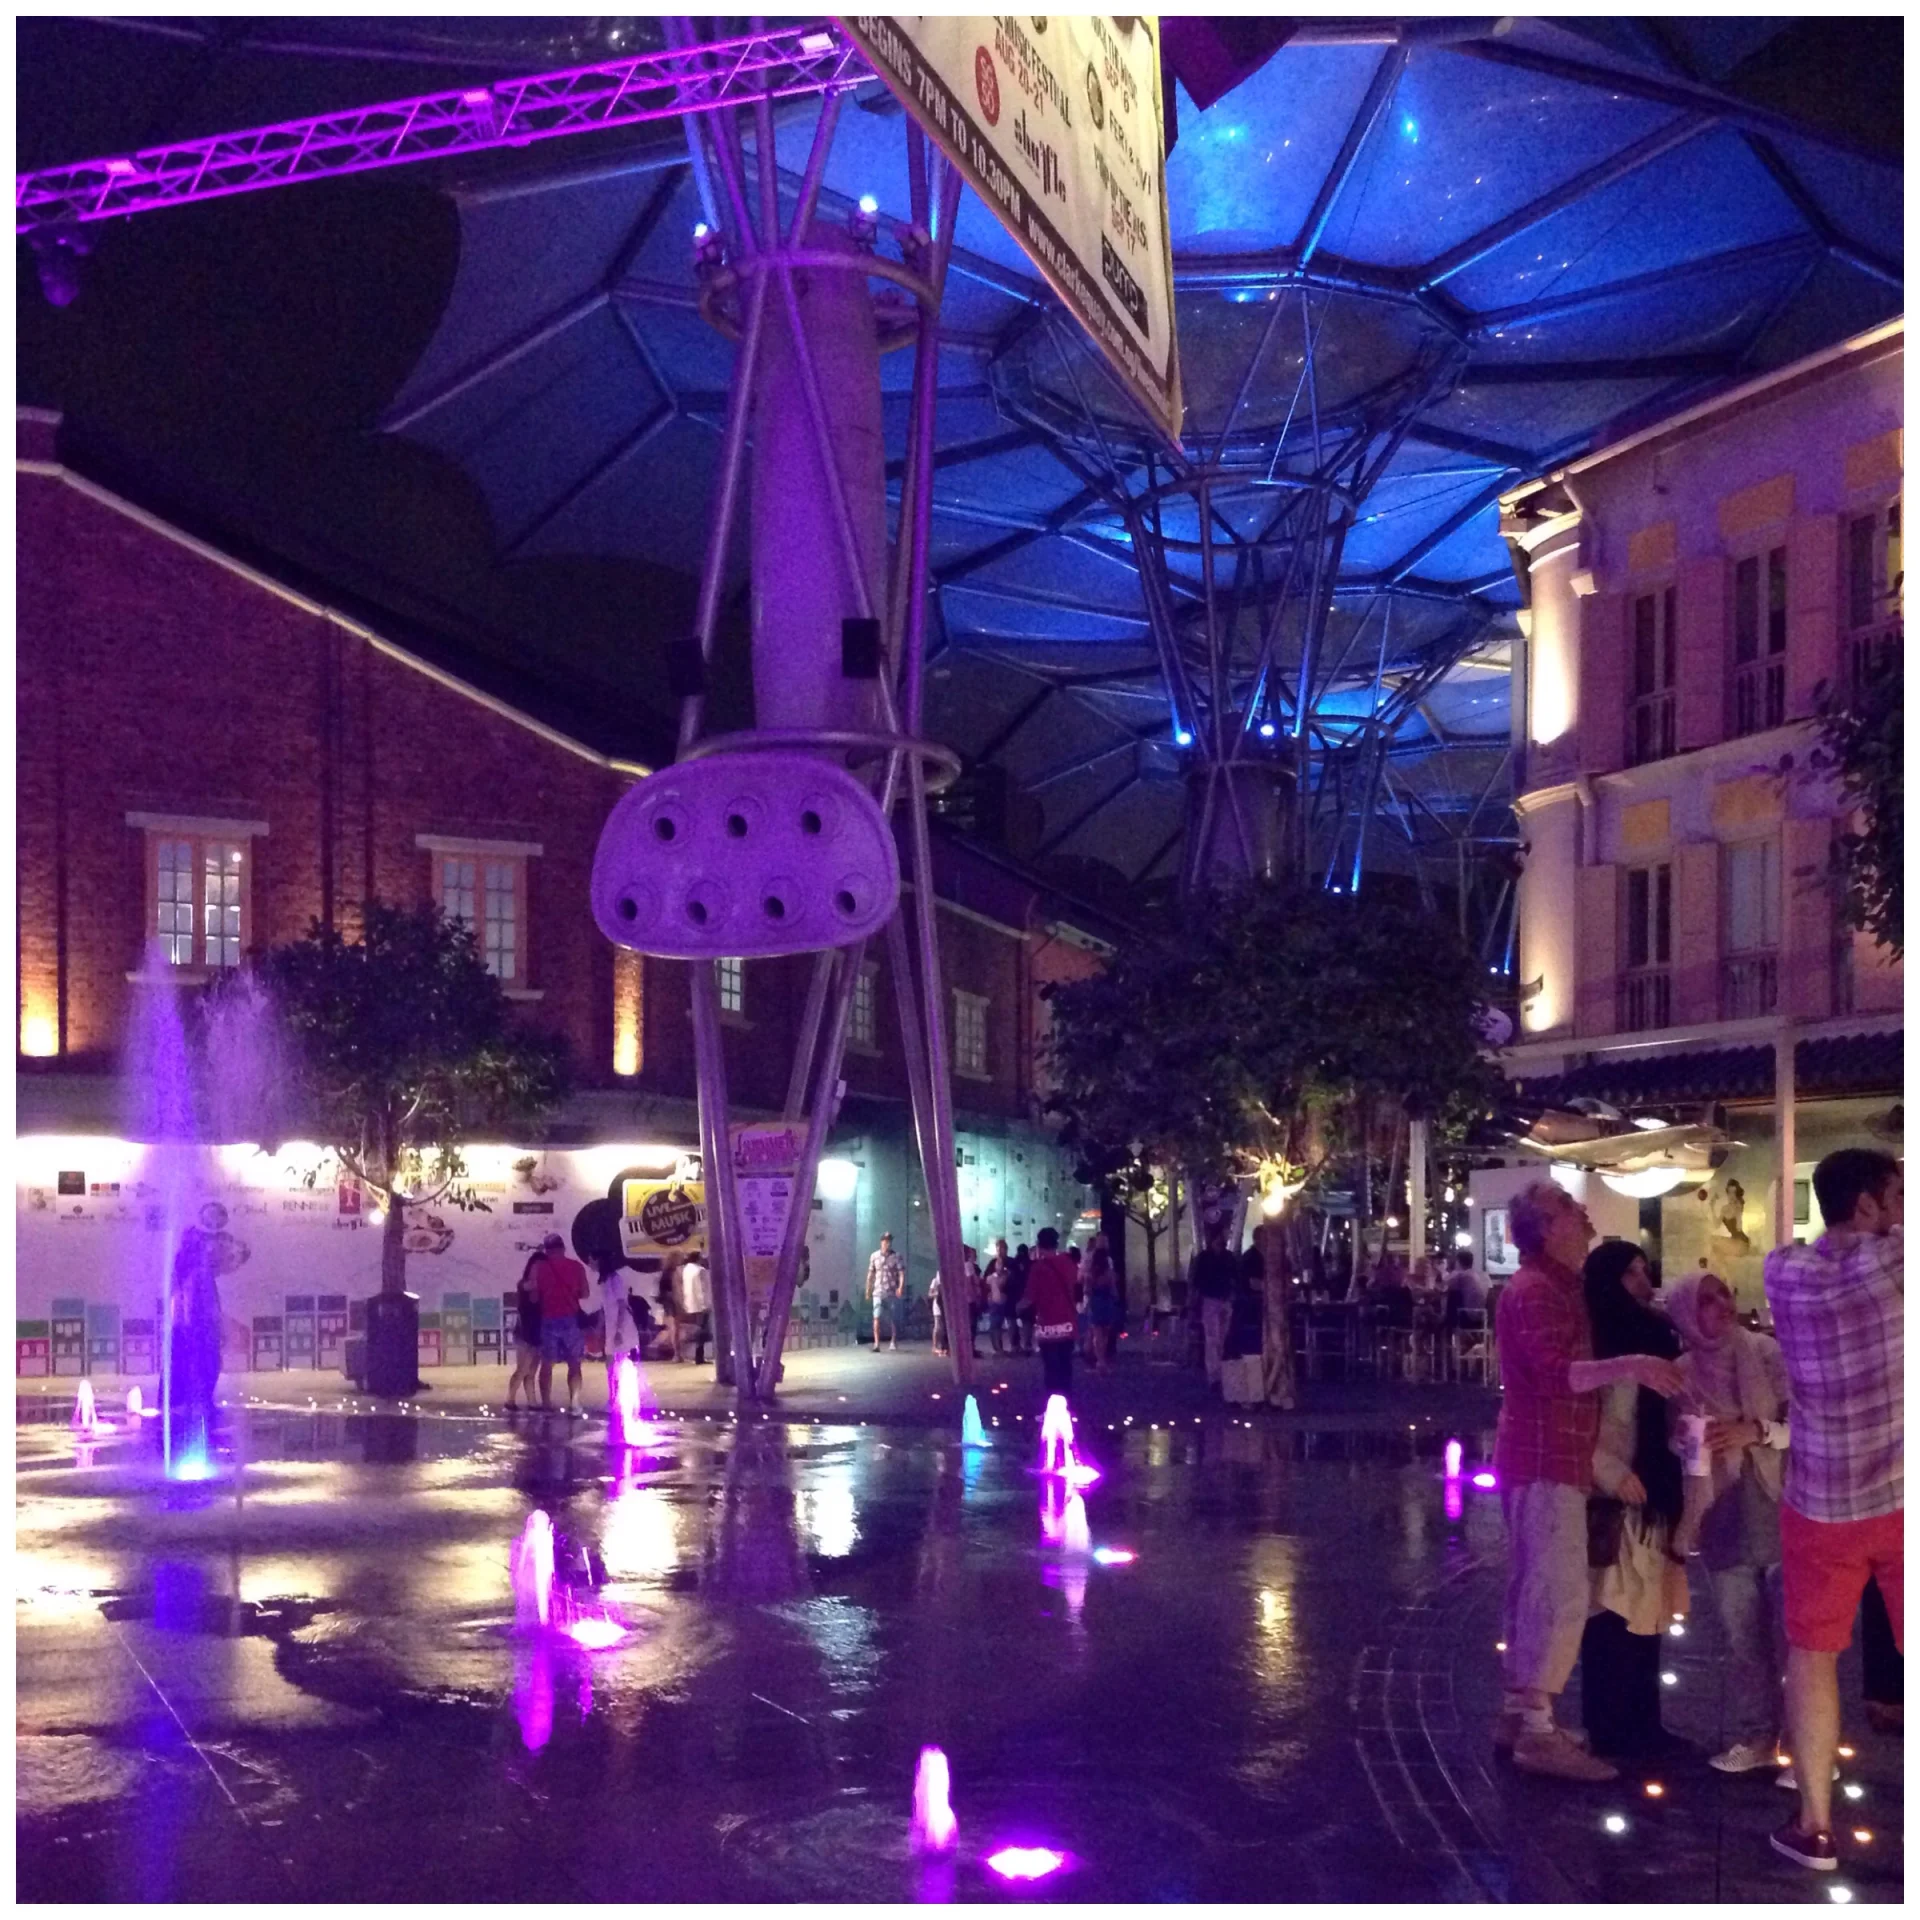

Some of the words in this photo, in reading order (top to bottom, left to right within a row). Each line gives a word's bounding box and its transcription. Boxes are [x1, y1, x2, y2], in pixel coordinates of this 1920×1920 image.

[995, 26, 1016, 77] AUG
[1018, 60, 1045, 117] 20-21
[858, 16, 912, 87] BEGINS
[916, 67, 947, 129] 7PM
[950, 107, 967, 154] TO
[971, 137, 1021, 224] 10.30PM
[646, 1201, 671, 1218] LIVE
[650, 1209, 693, 1233] MUSIC
